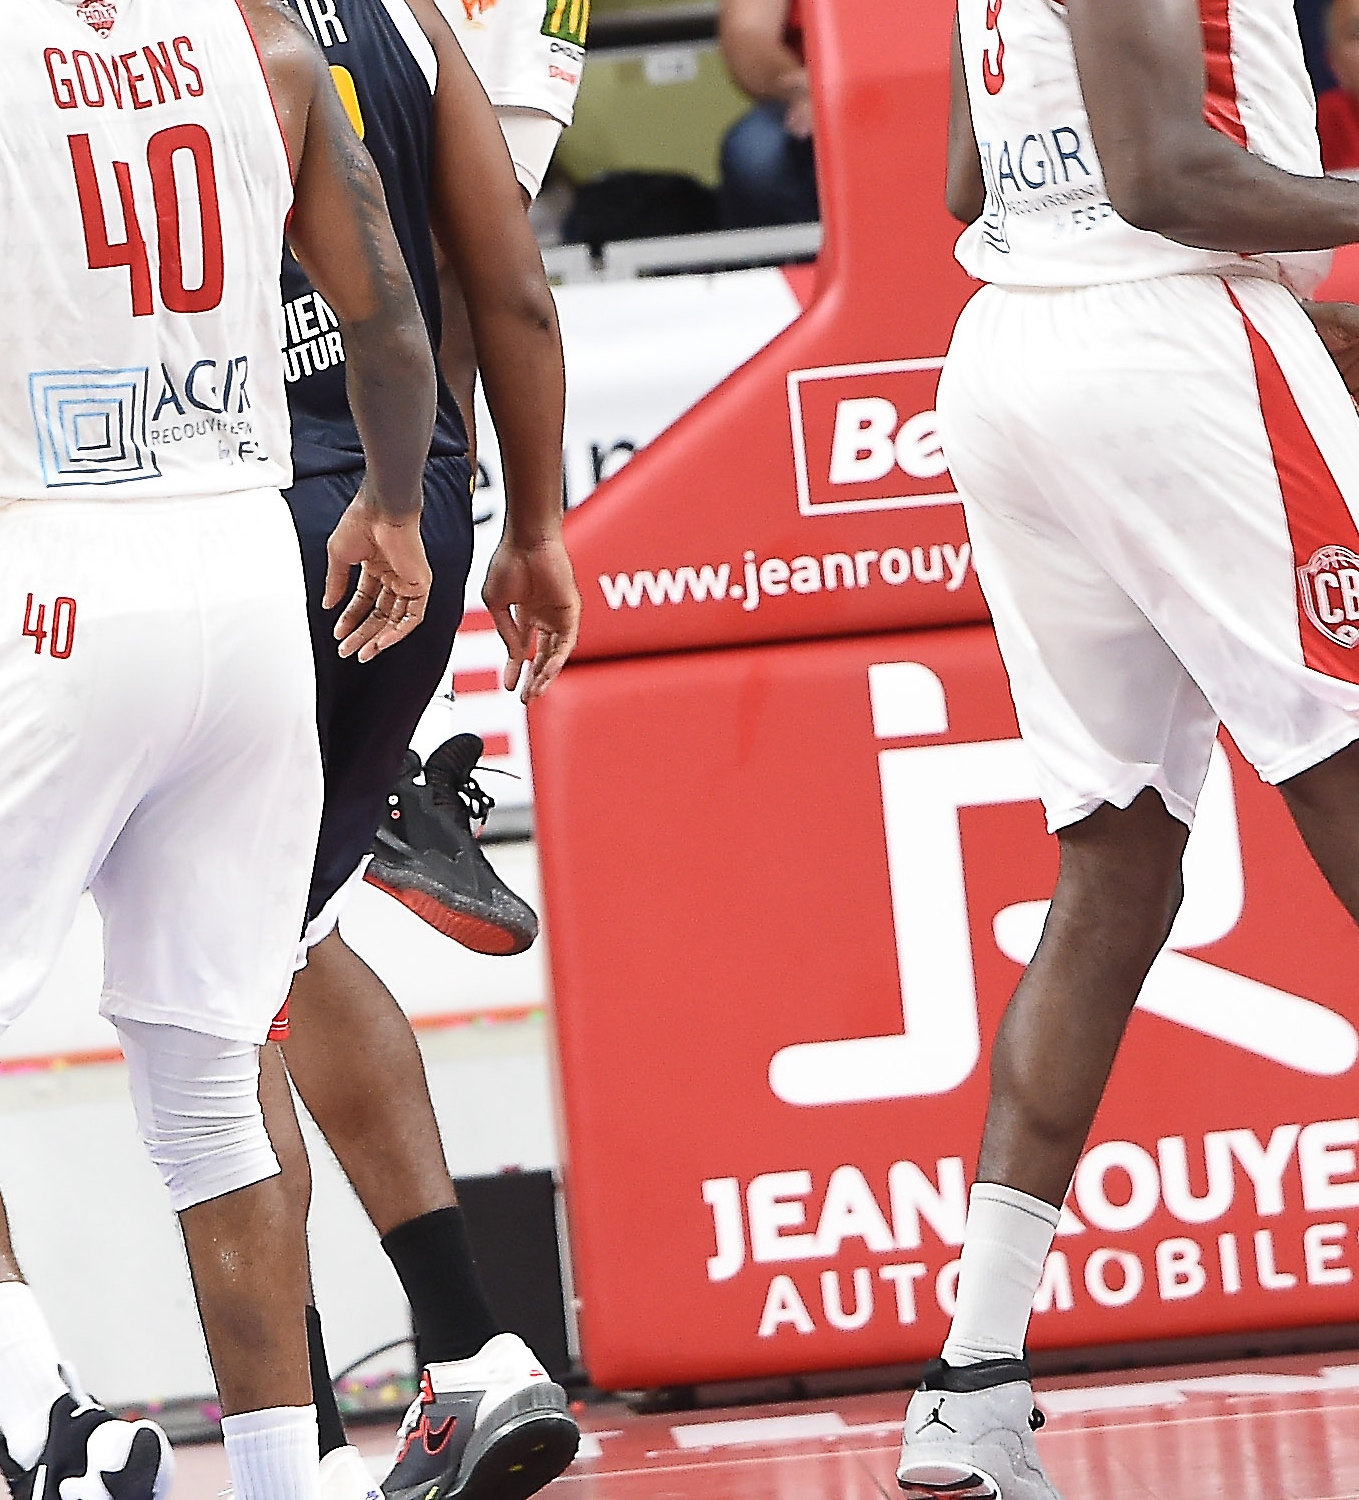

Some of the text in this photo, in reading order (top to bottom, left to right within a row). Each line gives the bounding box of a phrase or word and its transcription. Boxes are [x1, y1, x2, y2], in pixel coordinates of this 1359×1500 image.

[43, 35, 205, 111] GOVENS
[998, 126, 1091, 195] AGIR
[67, 123, 225, 317] 40
[829, 397, 951, 484] Be
[598, 542, 978, 612] www.jeanrouy
[22, 593, 77, 660] 40
[701, 1156, 971, 1282] JEAN
